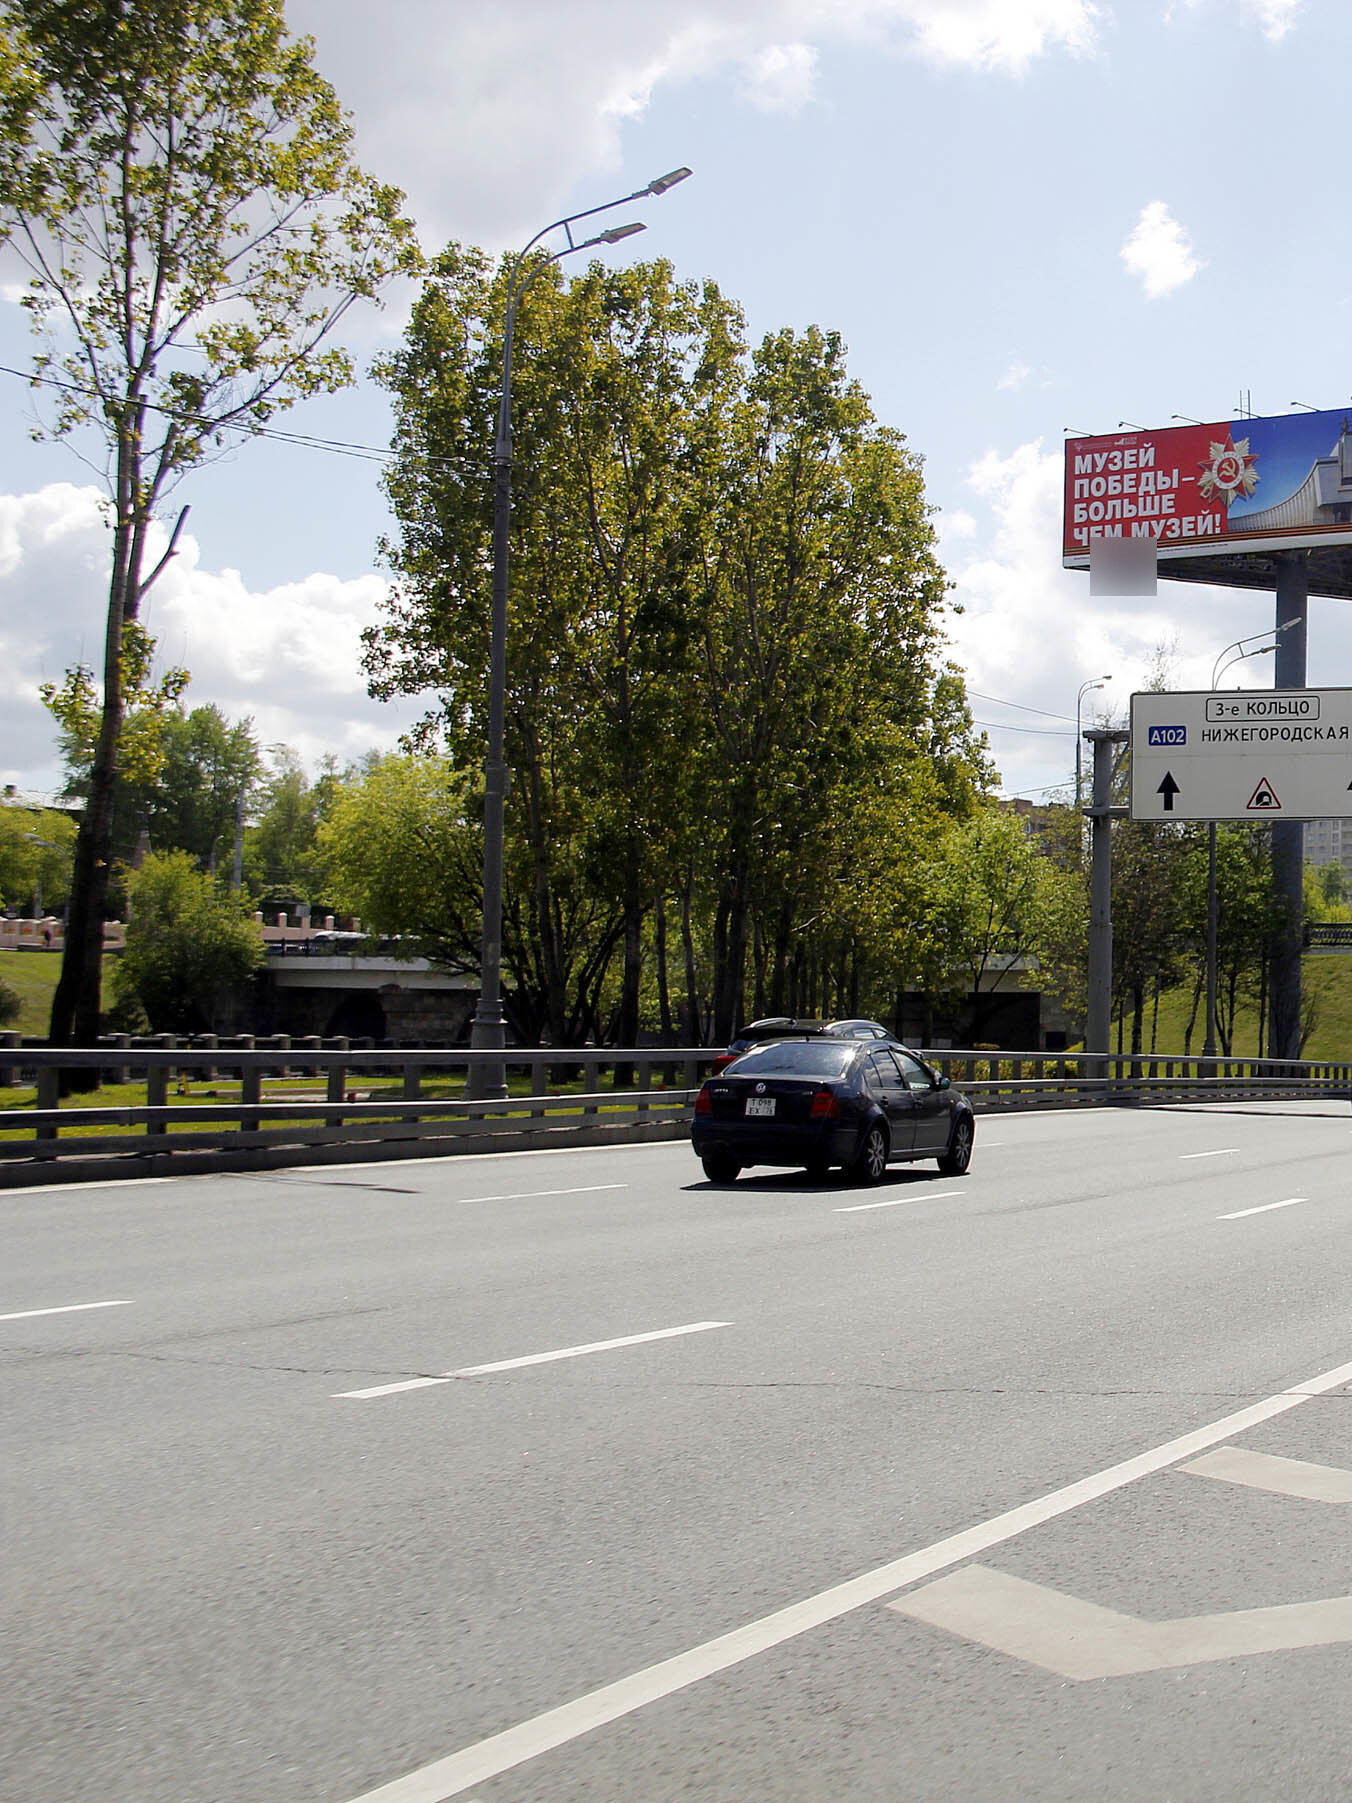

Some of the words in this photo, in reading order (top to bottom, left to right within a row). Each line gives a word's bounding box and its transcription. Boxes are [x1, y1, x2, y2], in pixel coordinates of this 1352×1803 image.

[1074, 442, 1155, 475] МУЗЕЙ
[1074, 493, 1176, 523] БОЛЬШЕ
[1131, 509, 1222, 539] МУЗЕЙ!
[1216, 703, 1239, 716] 3-е
[1246, 701, 1310, 717] КОЛЬЦО
[1202, 727, 1348, 742] НИЖЕГОРОДСКАЯ
